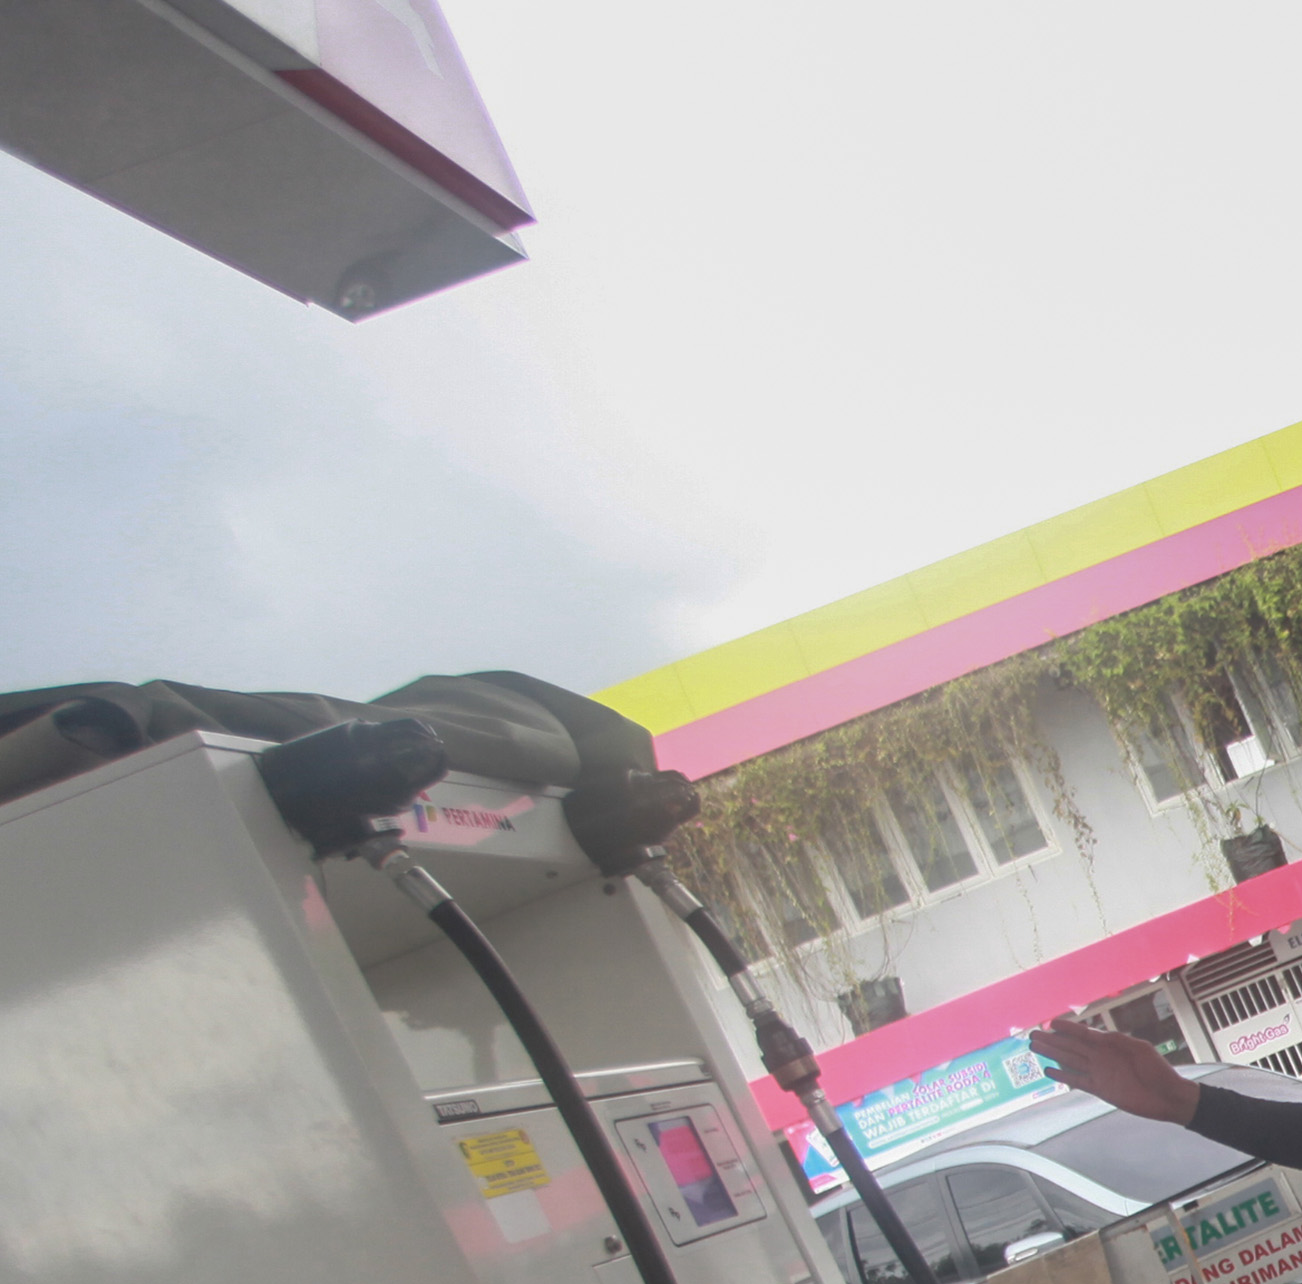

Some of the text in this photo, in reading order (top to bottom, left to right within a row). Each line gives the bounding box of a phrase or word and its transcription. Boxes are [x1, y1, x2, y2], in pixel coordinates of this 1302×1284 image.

[441, 806, 516, 832] PERTAMINA
[1230, 1024, 1289, 1055] Bright Gas
[854, 1062, 988, 1120] PEMBELIAN SOLAR SUBSIDI
[858, 1111, 886, 1130] DAN
[888, 1089, 944, 1116] PERTALITE
[946, 1074, 980, 1095] RODA
[862, 1116, 906, 1139] WAJIB
[907, 1086, 978, 1122] TERDAFTAR
[980, 1079, 997, 1094] DI
[1154, 1191, 1280, 1264] RTALITE
